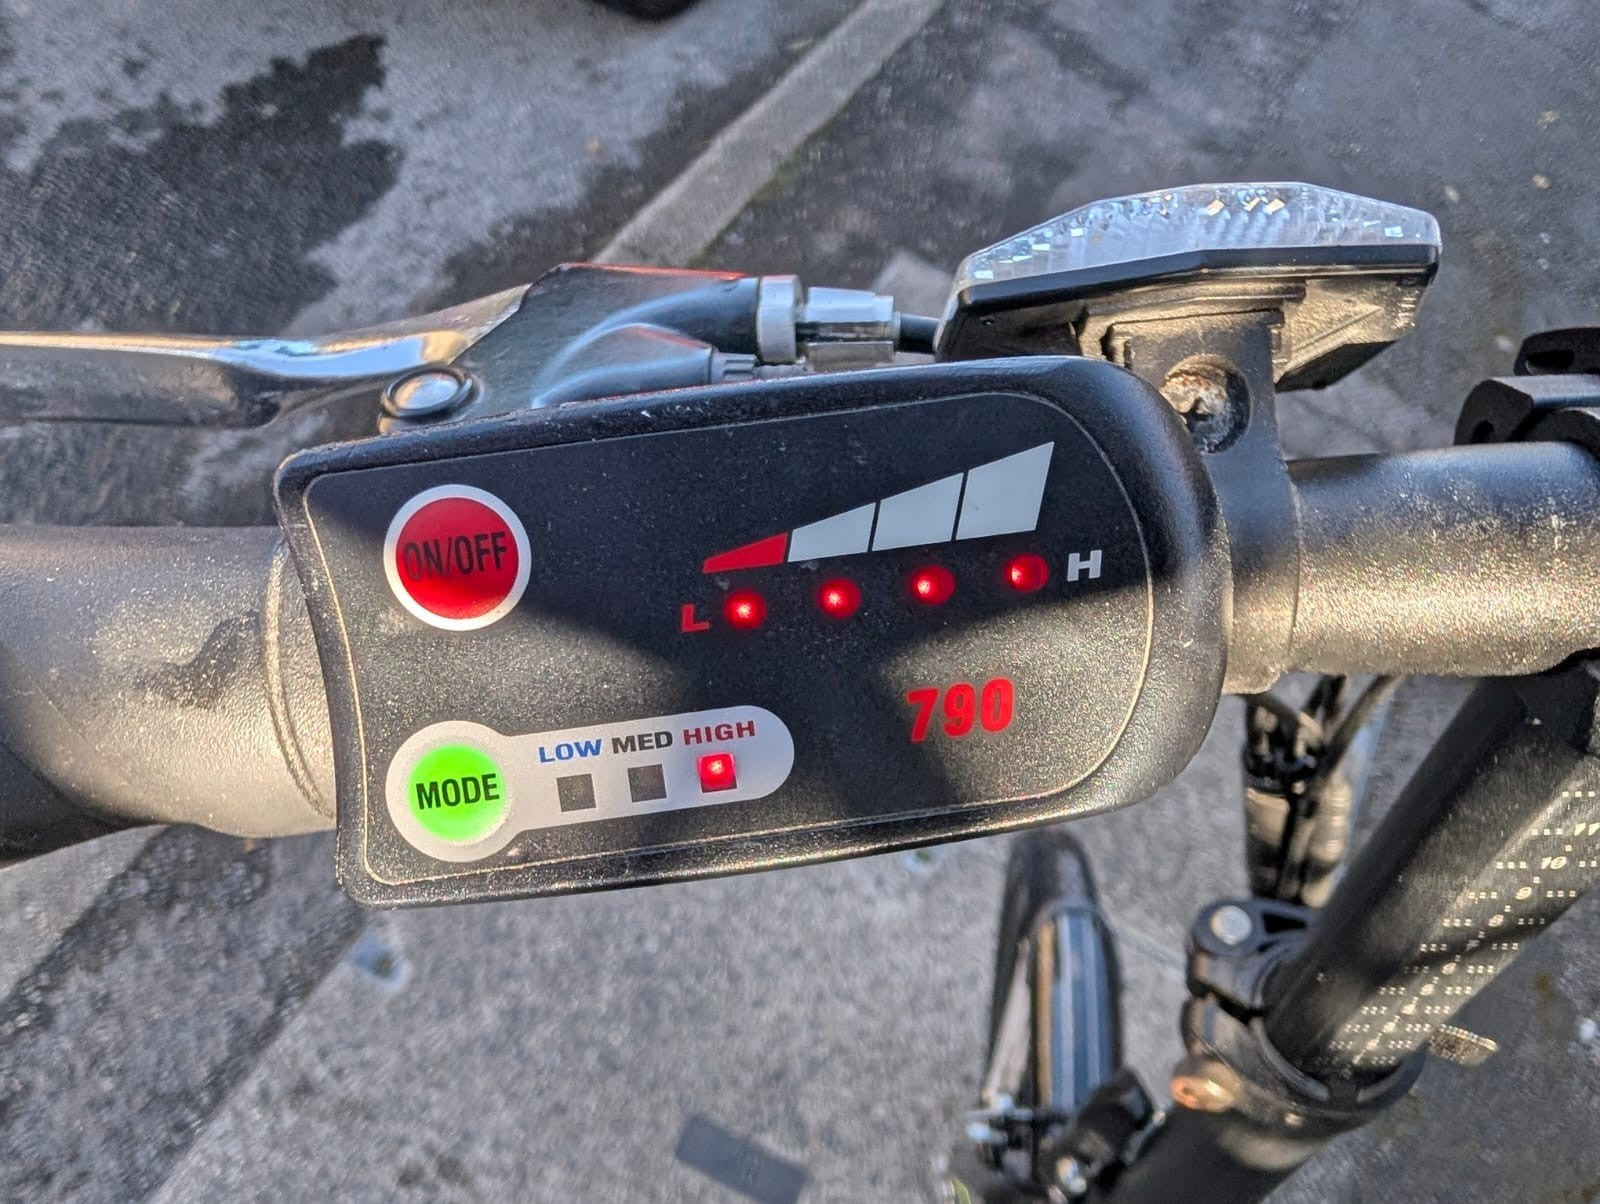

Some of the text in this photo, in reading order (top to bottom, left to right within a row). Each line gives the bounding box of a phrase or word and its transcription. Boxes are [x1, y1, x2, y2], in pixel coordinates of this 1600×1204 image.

[403, 531, 508, 582] ON/OFF
[1067, 550, 1102, 582] H
[680, 604, 710, 633] L
[907, 677, 1015, 742] 790
[538, 720, 756, 763] LOW MED HIGH
[415, 773, 500, 810] MODE
